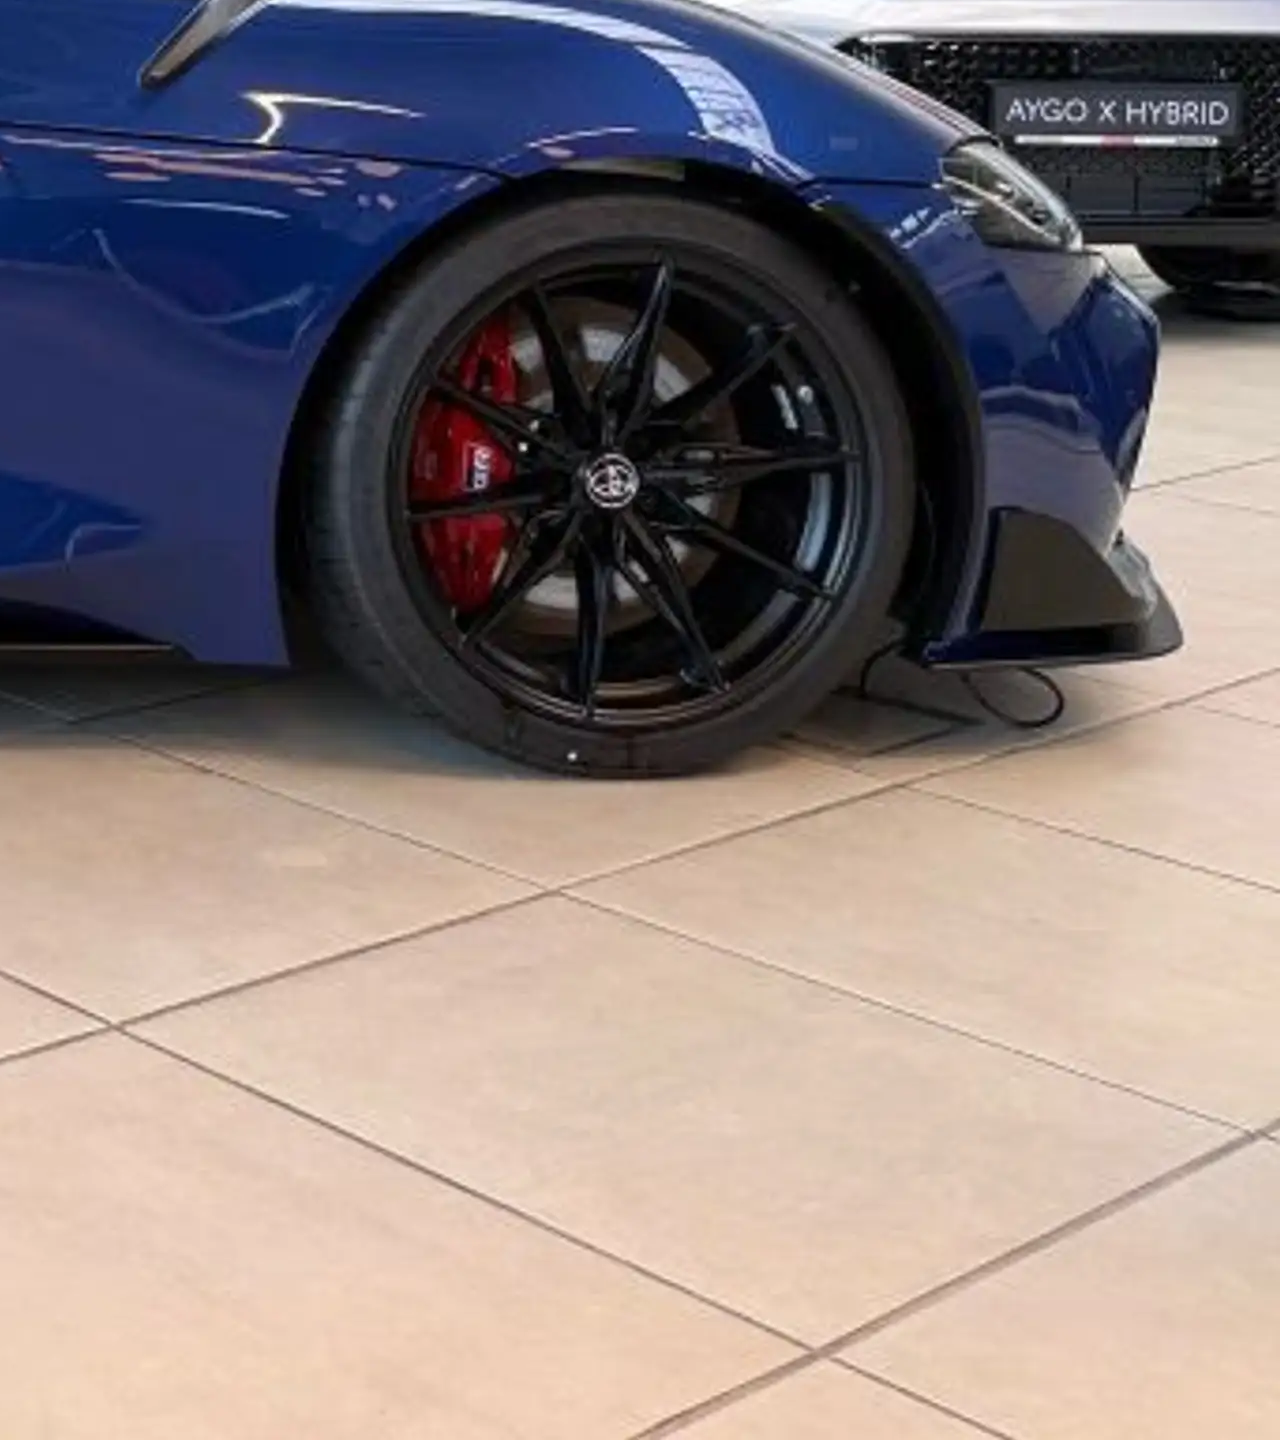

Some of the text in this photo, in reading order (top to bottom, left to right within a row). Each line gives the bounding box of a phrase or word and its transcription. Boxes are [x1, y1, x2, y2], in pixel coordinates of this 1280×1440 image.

[1005, 97, 1230, 126] AYGO X HYBRID
